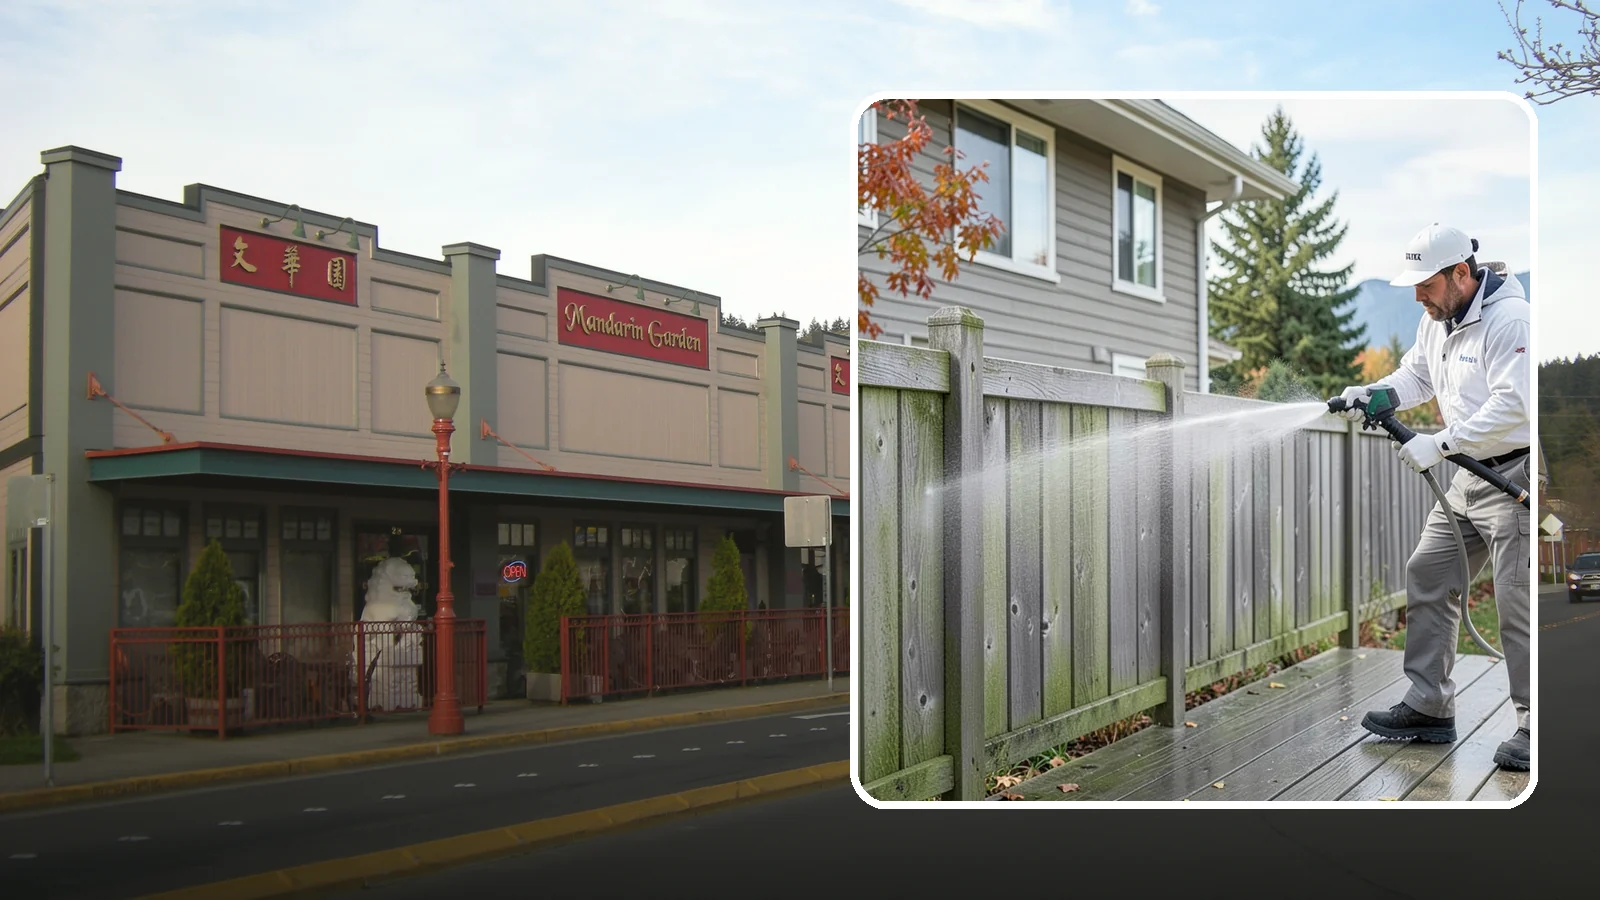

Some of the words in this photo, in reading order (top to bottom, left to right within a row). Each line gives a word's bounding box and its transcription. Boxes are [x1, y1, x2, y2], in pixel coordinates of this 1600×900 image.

[231, 235, 346, 291] 文華園
[564, 302, 644, 342] Mandarin
[648, 320, 701, 352] Garden
[835, 363, 846, 386] 文
[503, 565, 527, 578] OPEN
